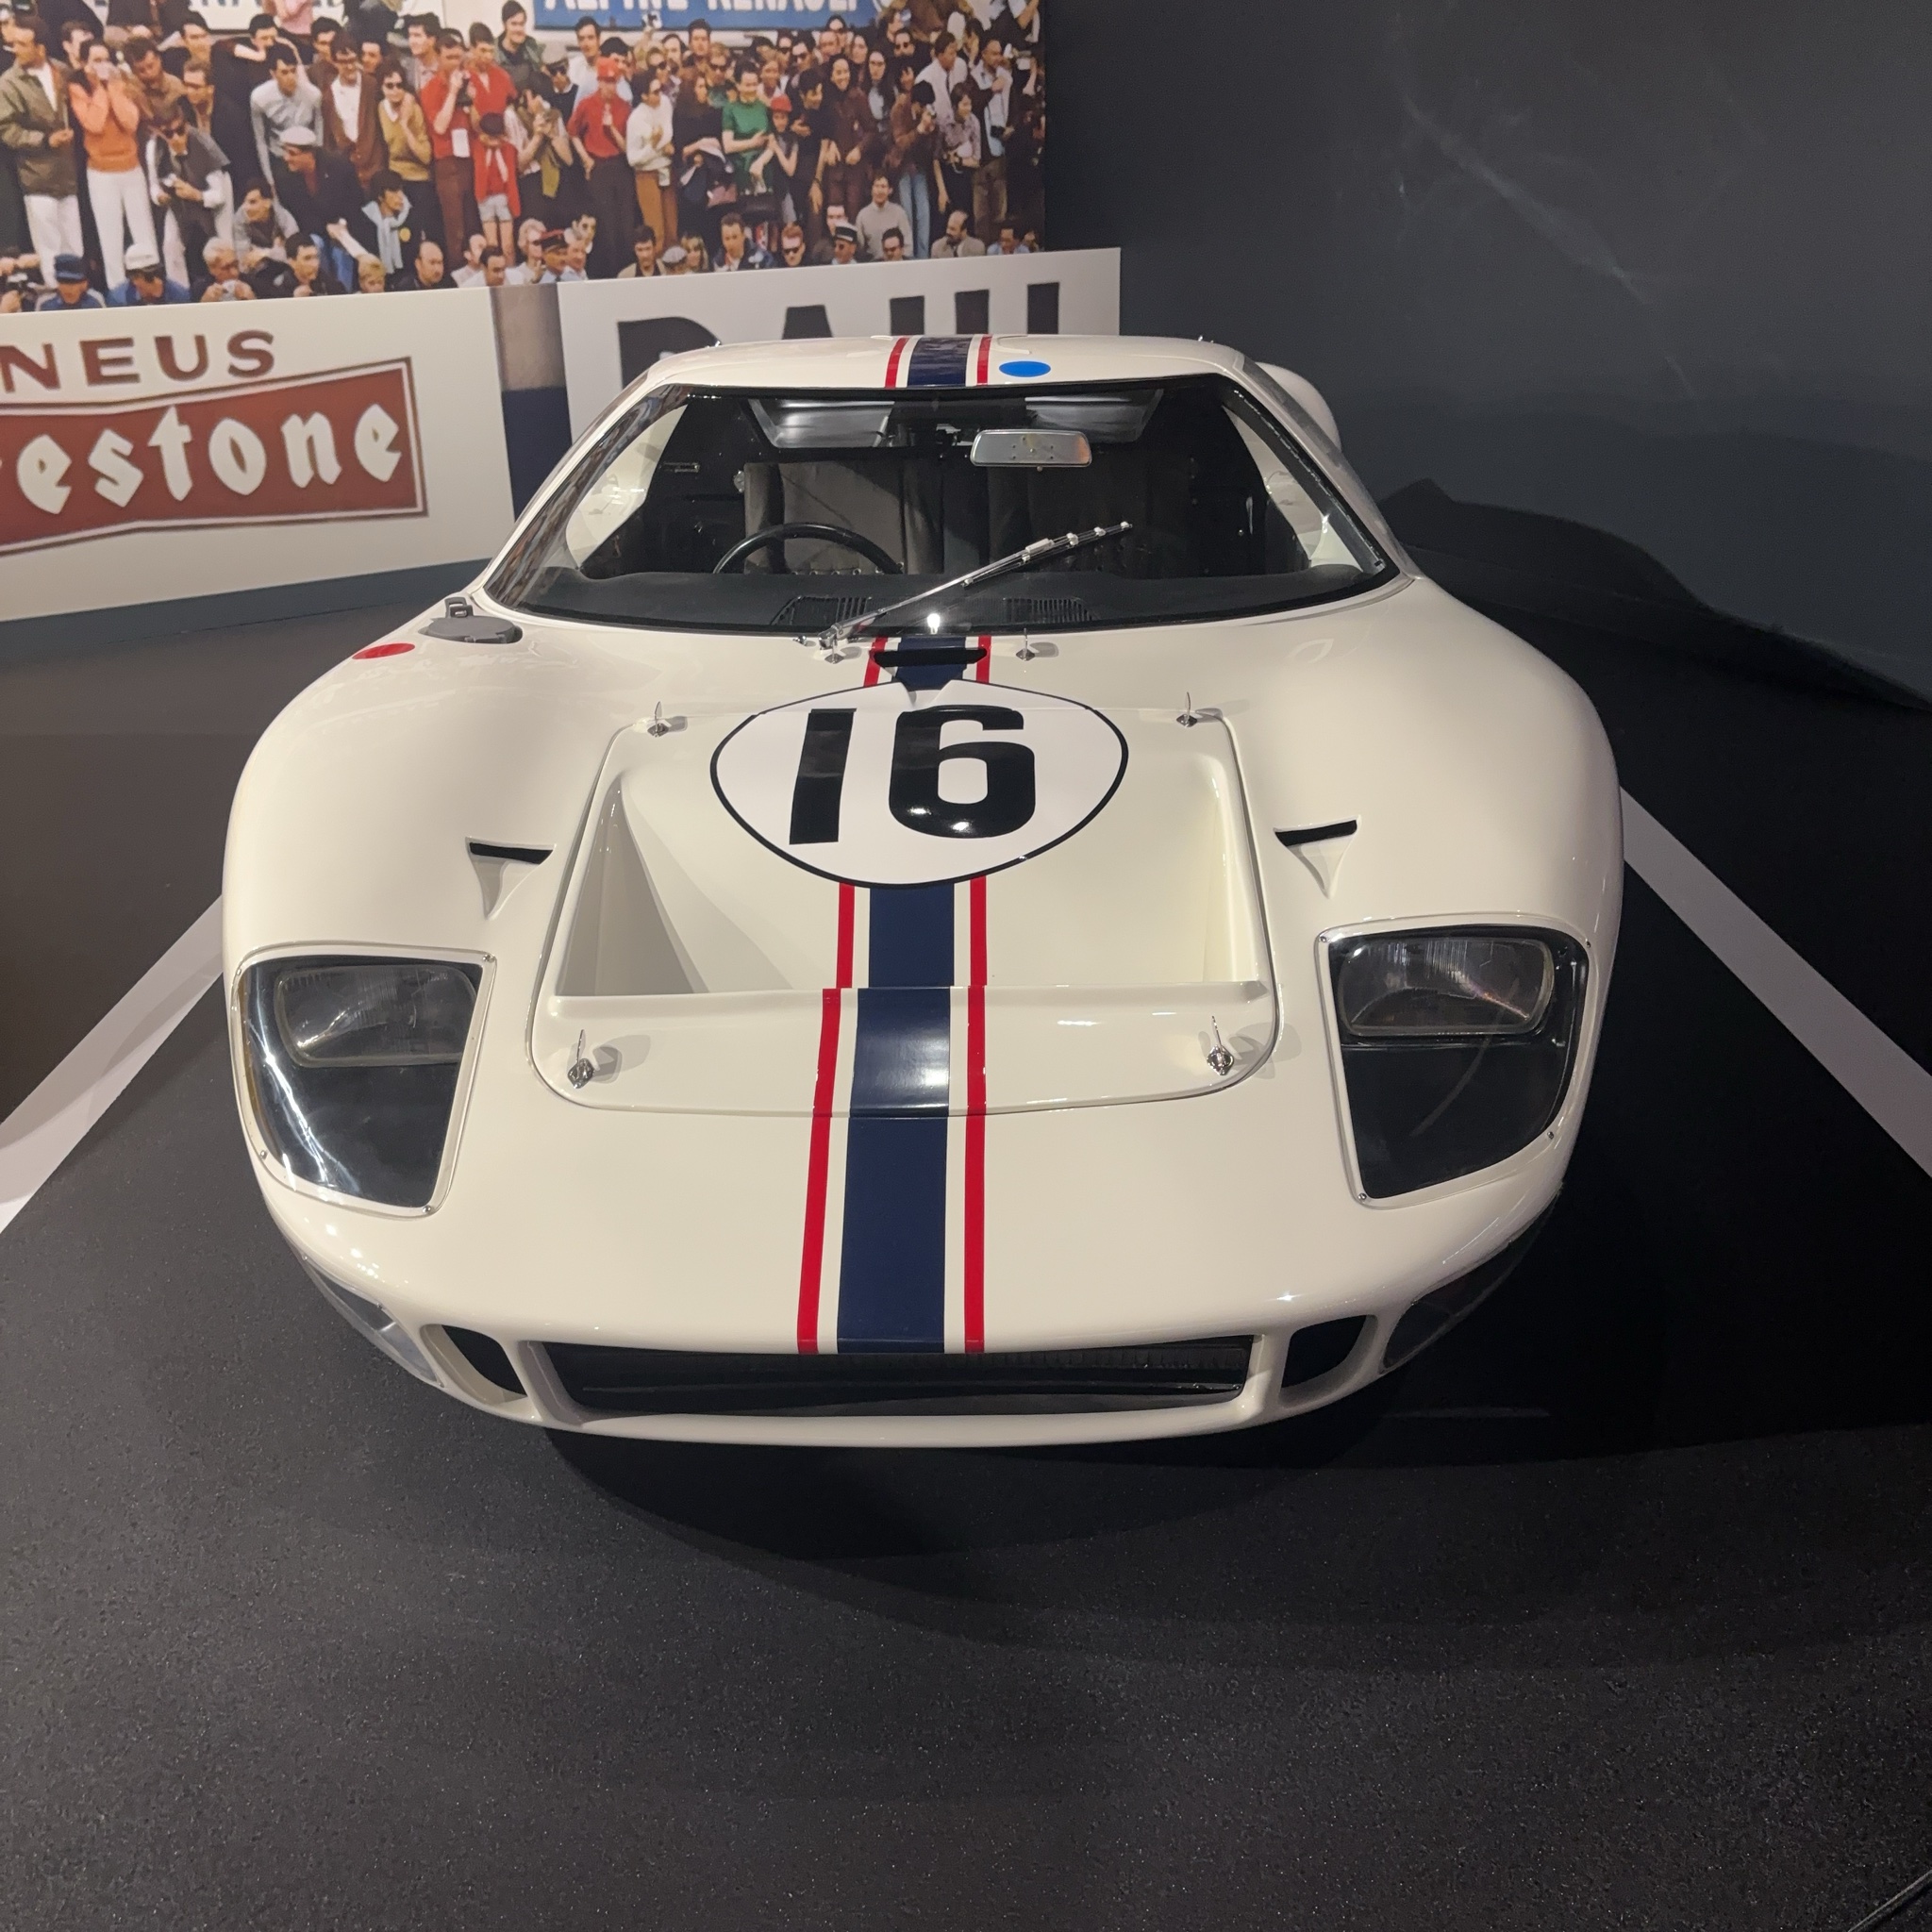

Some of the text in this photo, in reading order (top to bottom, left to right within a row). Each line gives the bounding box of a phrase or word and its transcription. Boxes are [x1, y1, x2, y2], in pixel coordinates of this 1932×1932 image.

[0, 329, 275, 393] NEUS
[0, 403, 402, 515] estone
[789, 704, 1036, 845] 16
